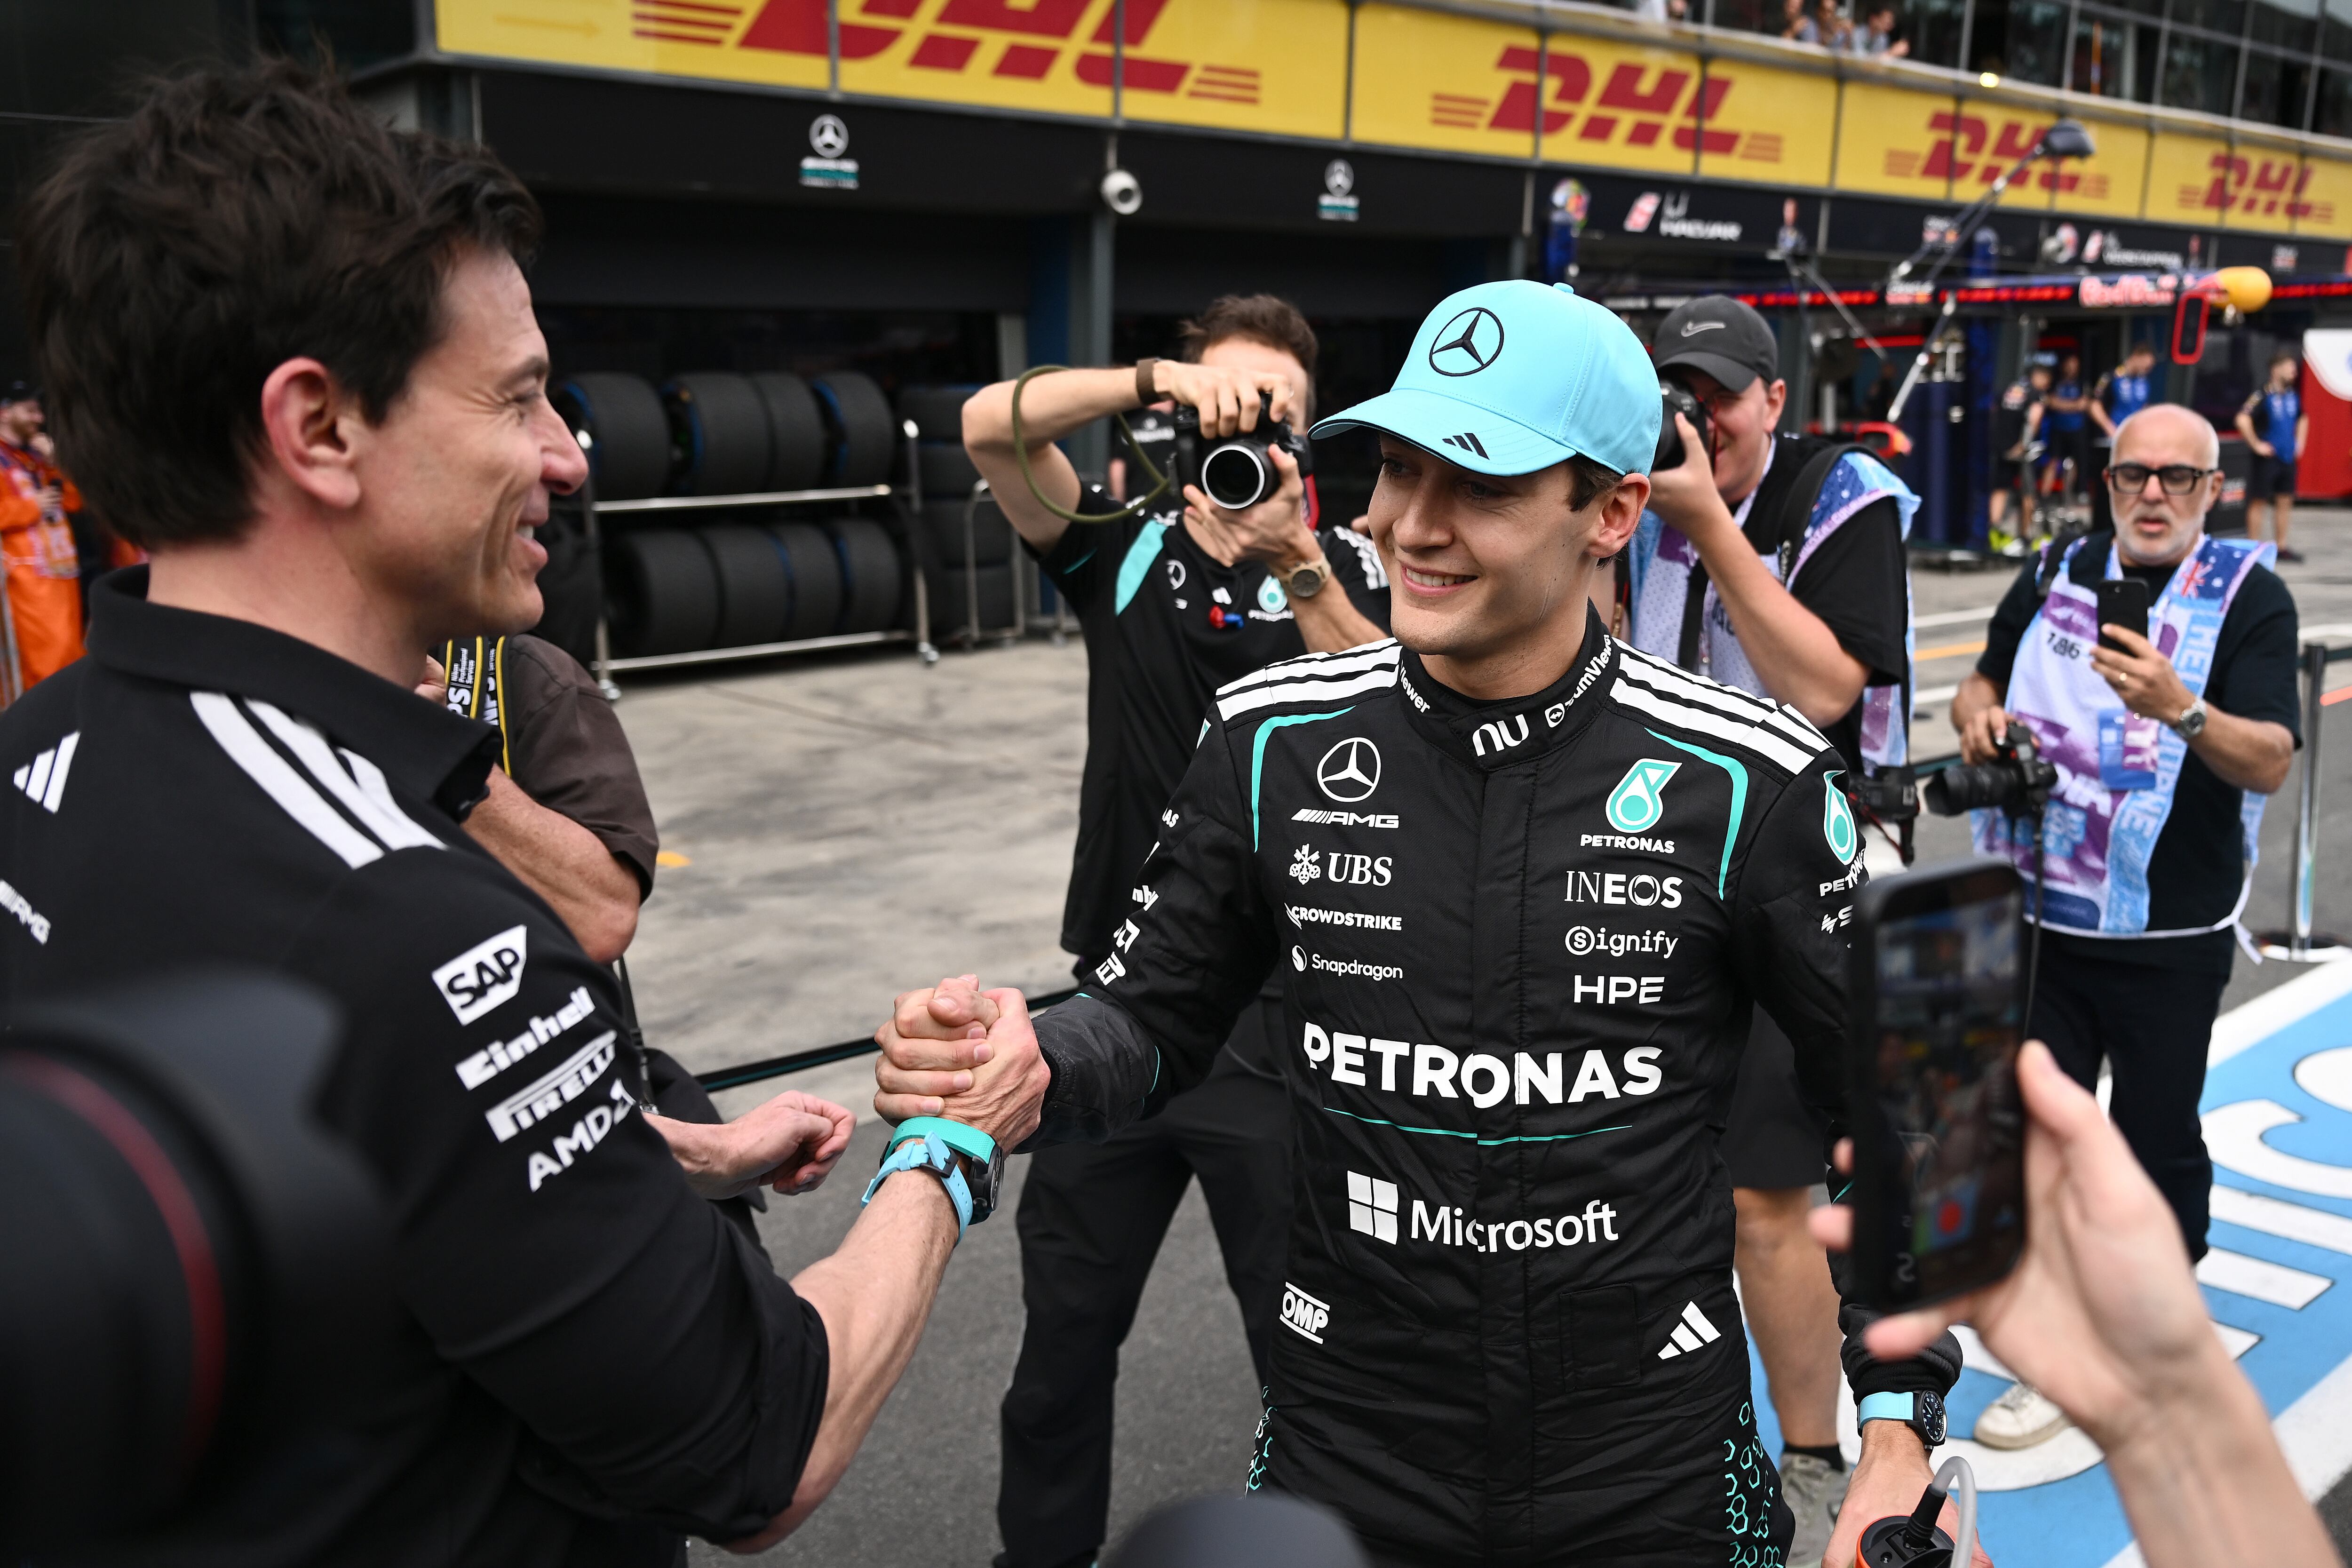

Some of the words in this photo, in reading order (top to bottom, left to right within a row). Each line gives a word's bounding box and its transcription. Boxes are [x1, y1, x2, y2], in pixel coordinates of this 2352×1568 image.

[1487, 44, 1742, 156] DHL
[2204, 154, 2312, 218] DHL
[447, 687, 471, 718] PS
[1325, 811, 1399, 828] AMG
[1580, 834, 1675, 854] PETRONAS
[1328, 852, 1393, 886] UBS
[1564, 871, 1683, 908] INEOS
[1291, 906, 1402, 931] CROWDSTRIKE
[447, 948, 520, 1010] SAP
[1312, 954, 1403, 981] Snapdragon
[1574, 975, 1665, 1004] HPE
[455, 986, 596, 1091] Einhell
[485, 1029, 617, 1143] PIRELLI
[1303, 1021, 1663, 1109] PETRONAS
[528, 1105, 612, 1193] AMD
[1411, 1199, 1620, 1252] Microsoft
[1282, 1291, 1328, 1334] OMP
